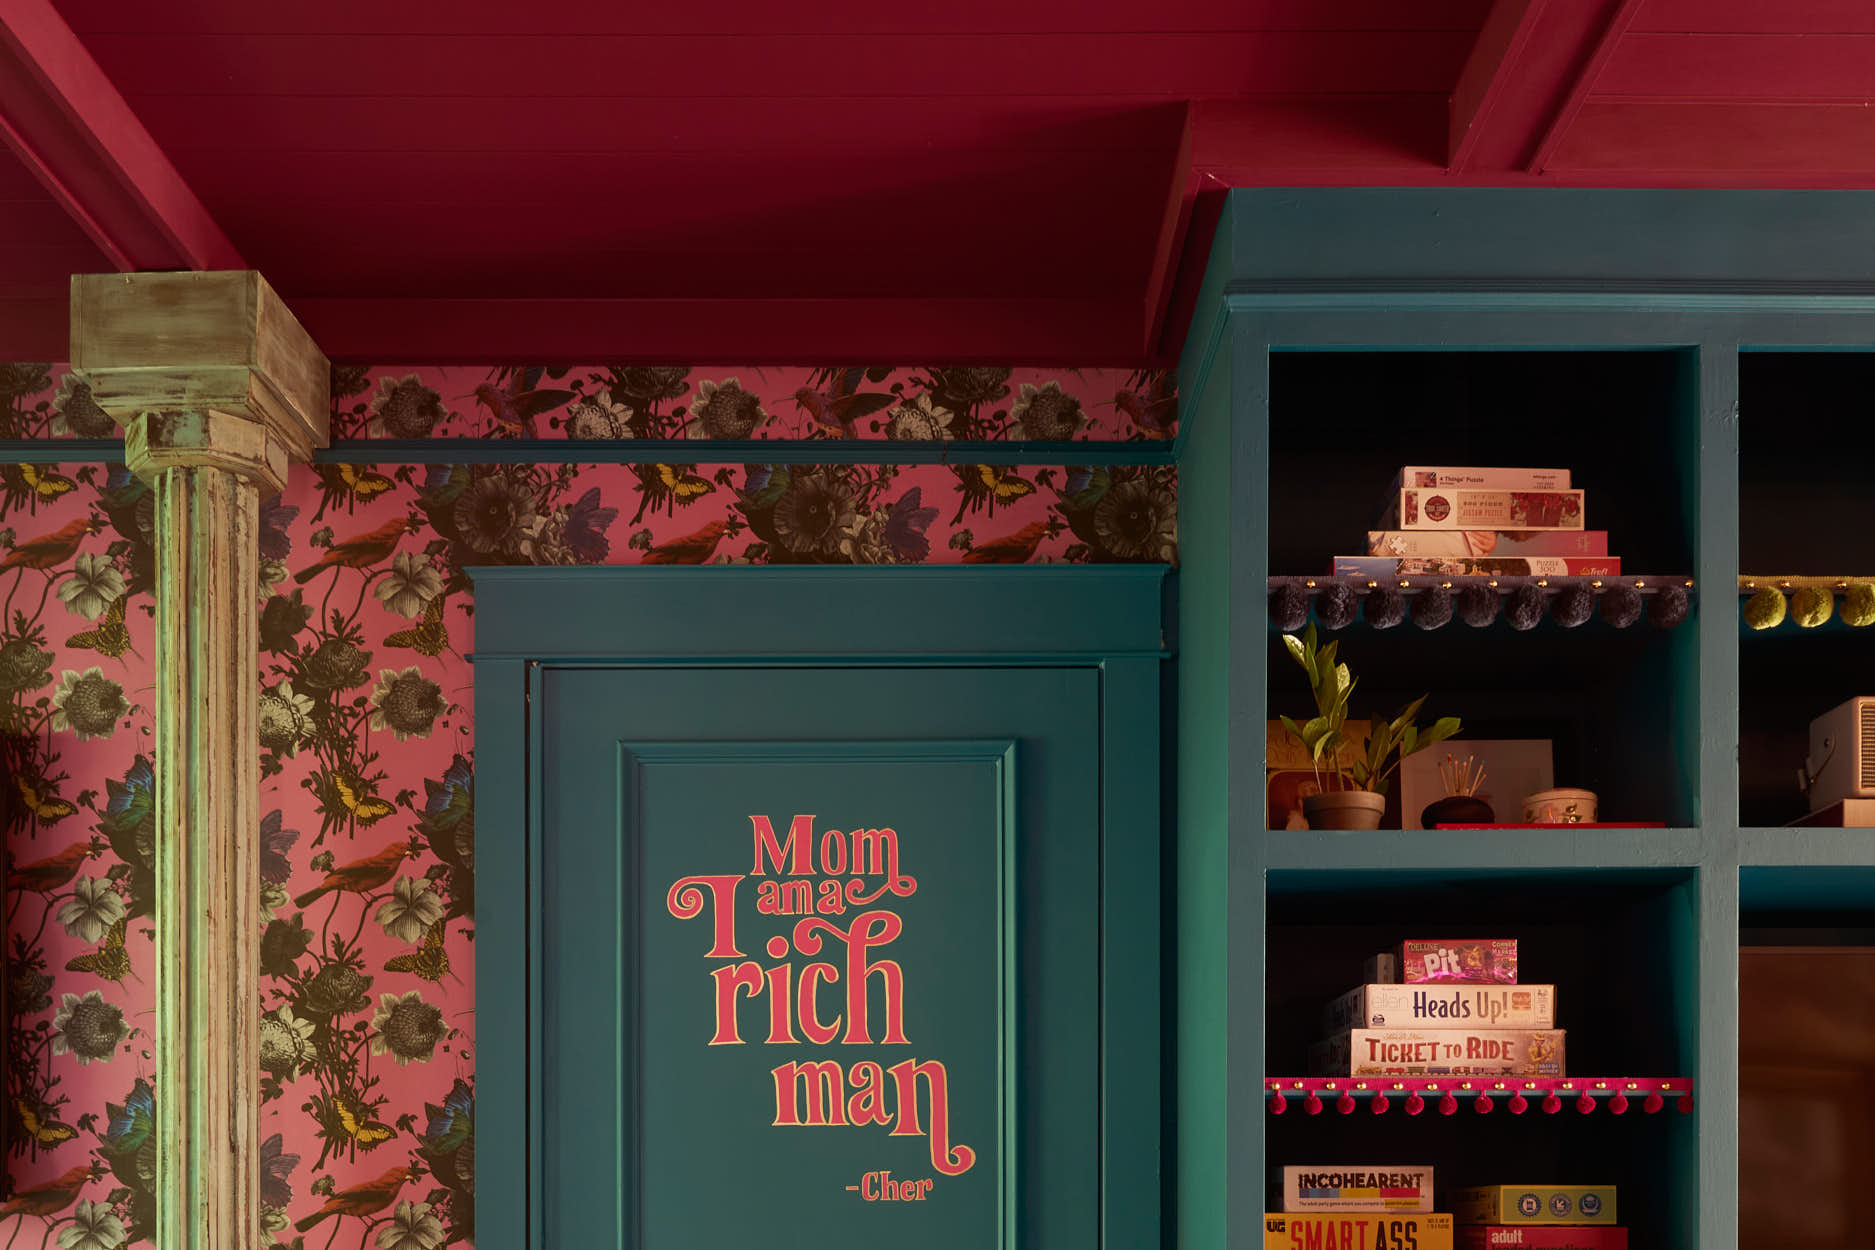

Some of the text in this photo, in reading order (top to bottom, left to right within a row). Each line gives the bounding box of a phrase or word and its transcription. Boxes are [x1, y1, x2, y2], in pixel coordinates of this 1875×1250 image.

[749, 814, 917, 906] Mom
[667, 875, 848, 957] I am a
[1408, 943, 1439, 951] DELUXE
[708, 910, 912, 1046] rich
[1424, 948, 1463, 979] Pit
[1413, 991, 1471, 1018] Heads
[1477, 991, 1508, 1025] Up!
[1365, 1036, 1515, 1063] TICKET TO RIDE
[771, 1059, 976, 1176] man
[846, 1171, 933, 1201] -Cher
[1298, 1173, 1425, 1189] INCOHEARENT
[1491, 1230, 1523, 1244] adult
